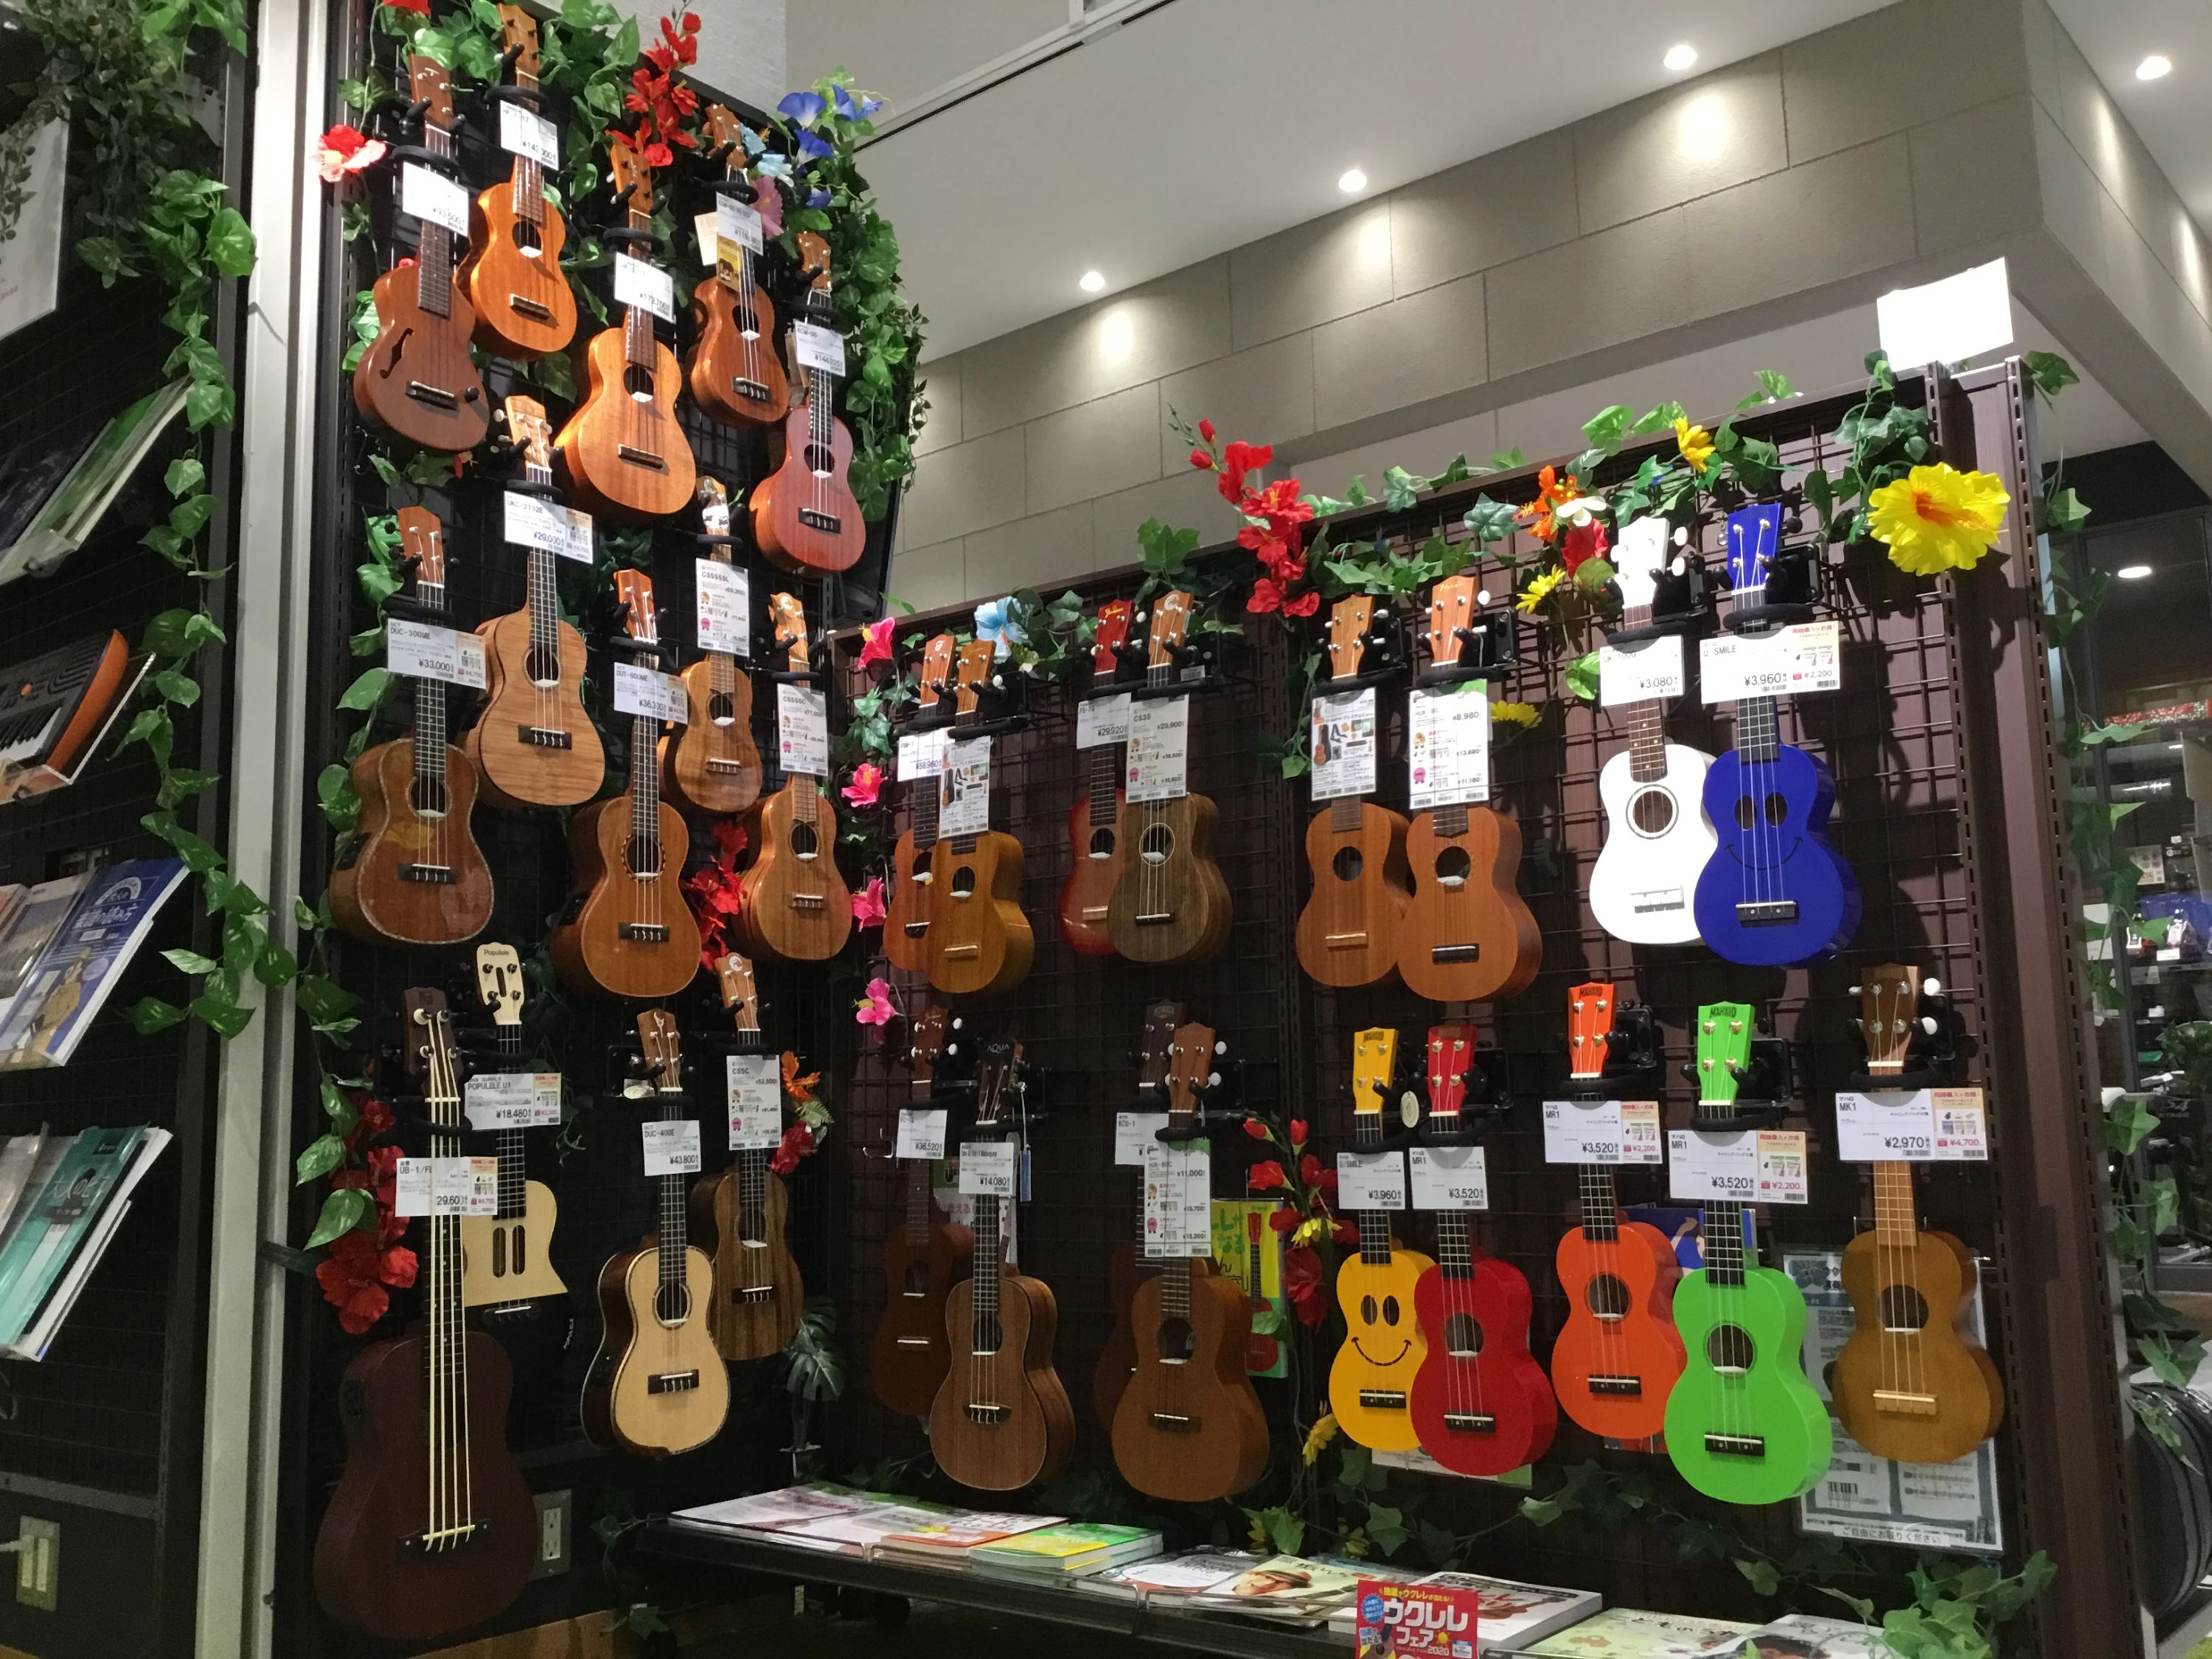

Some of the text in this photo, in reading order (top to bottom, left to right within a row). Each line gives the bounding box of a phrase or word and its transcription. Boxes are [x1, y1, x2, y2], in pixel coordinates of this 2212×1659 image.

[419, 658, 451, 672] ¥33,000
[1745, 672, 1781, 686] ¥3,960
[1804, 669, 1833, 678] ¥2,200
[1640, 676, 1673, 689] ¥3,080
[1133, 713, 1151, 722] CS35
[1453, 711, 1479, 721] ¥8,980
[1098, 725, 1124, 737] ¥29,920
[1709, 1006, 1736, 1018] MAHALO
[987, 1043, 1009, 1054] AQUA
[1840, 1102, 1857, 1111] MK1
[495, 1108, 528, 1119] ¥18,480
[1545, 1110, 1559, 1119] MR1
[915, 1143, 939, 1151] ¥36,520
[1582, 1142, 1614, 1153] ¥3,520
[1632, 1144, 1656, 1152] ¥2,200
[1672, 1141, 1687, 1150] MR1
[1885, 1136, 1924, 1149] ¥2,970
[1950, 1138, 1980, 1147] ¥4,700
[669, 1155, 695, 1165] ¥43,800
[1412, 1157, 1427, 1165] MR1
[980, 1177, 1006, 1186] ¥14,080
[1711, 1176, 1748, 1189] ¥3,520
[1772, 1181, 1801, 1190] ¥2,200
[1368, 1189, 1397, 1200] ¥3,960
[1449, 1188, 1479, 1199] ¥3,520
[1843, 1526, 1941, 1543] ご自由にお取りください
[1383, 1597, 1469, 1632] ウクレレ
[1397, 1626, 1434, 1648] フェア
[1427, 1645, 1450, 1656] 2020
